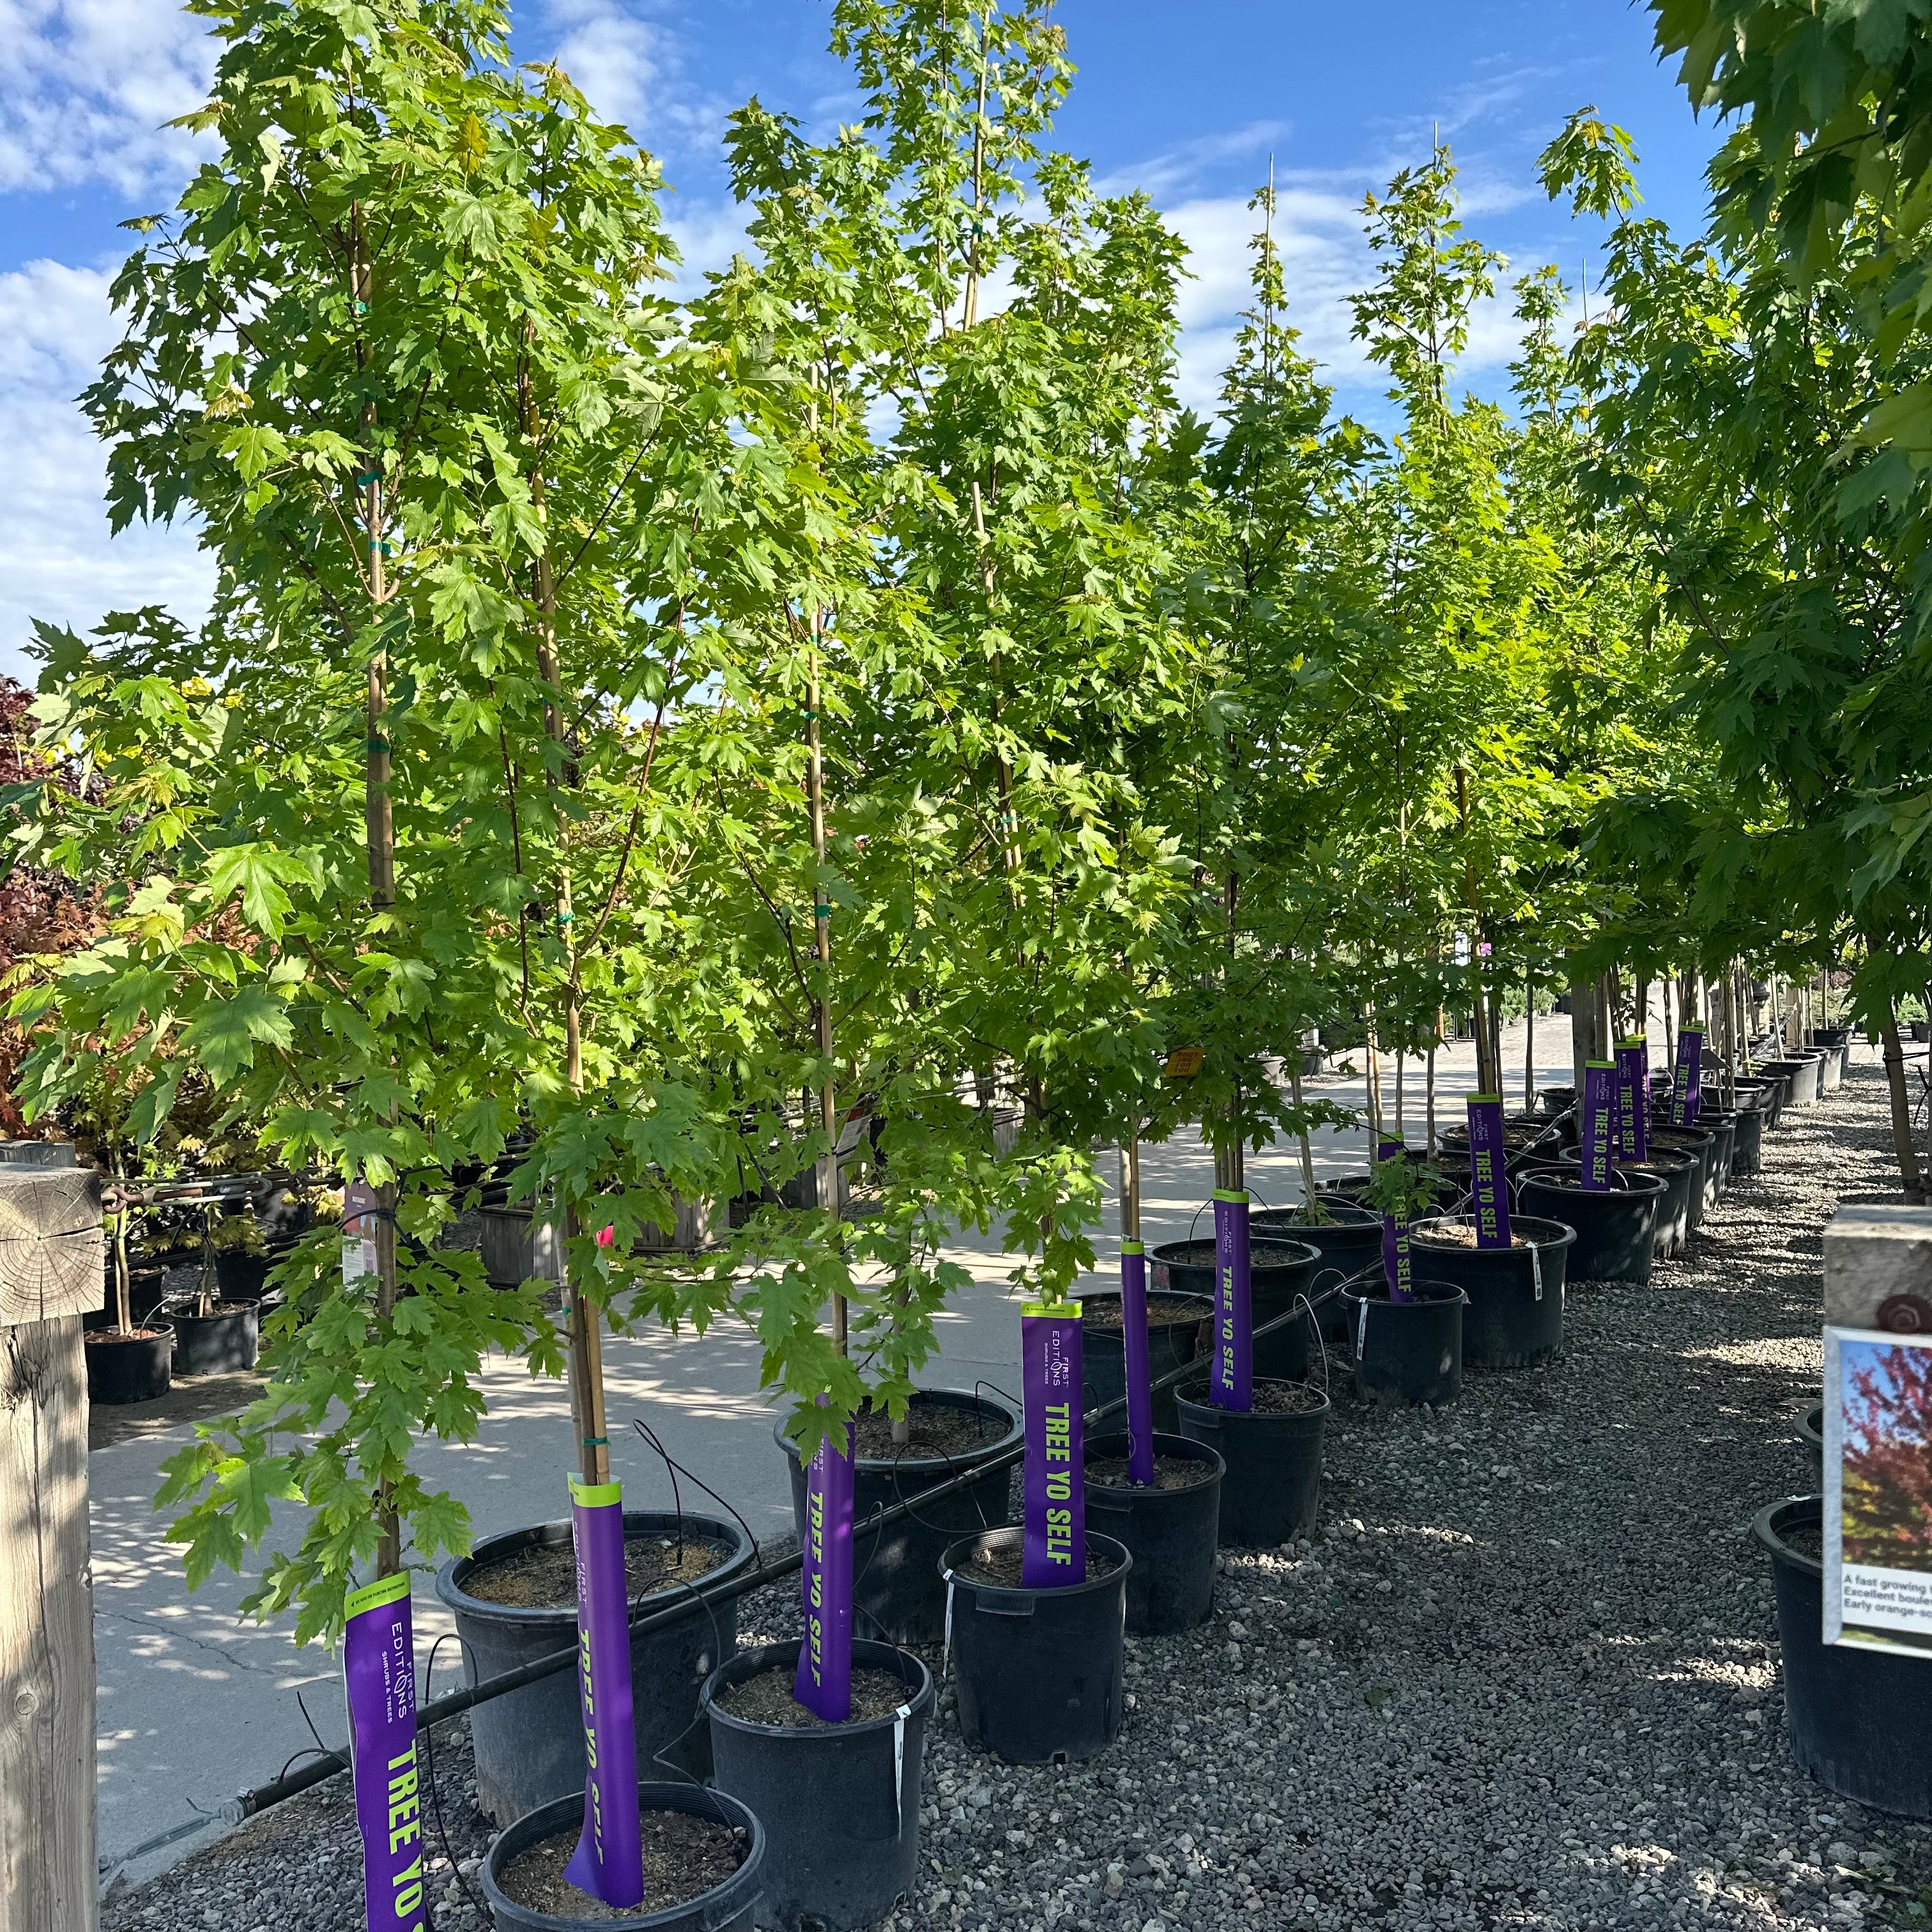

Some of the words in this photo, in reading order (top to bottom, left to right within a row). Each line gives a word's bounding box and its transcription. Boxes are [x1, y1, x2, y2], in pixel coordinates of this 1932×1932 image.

[1677, 1063, 1690, 1086] TREE
[1620, 1085, 1633, 1110] TREE
[1675, 1089, 1687, 1101] YO
[1595, 1107, 1609, 1136] TREE
[1621, 1114, 1634, 1127] YO
[1673, 1102, 1685, 1125] SELF
[1594, 1139, 1607, 1154] YO
[1622, 1130, 1636, 1154] SELF
[1475, 1149, 1493, 1183] TREE
[1592, 1156, 1607, 1184] SELF
[1478, 1186, 1494, 1204] YO
[1480, 1207, 1498, 1239] SELF
[1395, 1236, 1409, 1253] YO
[1222, 1266, 1232, 1312] TREE
[1397, 1258, 1411, 1292] SELF
[1222, 1318, 1233, 1340] YO
[1051, 1330, 1061, 1386] EDITIONS
[1222, 1345, 1234, 1390] SELF
[1045, 1402, 1070, 1462] TREE
[1046, 1470, 1071, 1500] YO
[809, 1492, 823, 1563] TREE
[1046, 1508, 1071, 1565] SELF
[810, 1570, 822, 1609] YO
[1844, 1574, 1852, 1584] A
[1855, 1575, 1877, 1586] fast
[1881, 1581, 1926, 1595] growing
[1844, 1586, 1896, 1601] Excellent
[1844, 1598, 1872, 1612] Early
[809, 1614, 822, 1687] SELF
[381, 1651, 390, 1686] SHRUBS
[392, 1621, 407, 1719] EDITIONS
[580, 1629, 594, 1715] TREE
[388, 1738, 421, 1855] TREE
[392, 1853, 423, 1918] YO
